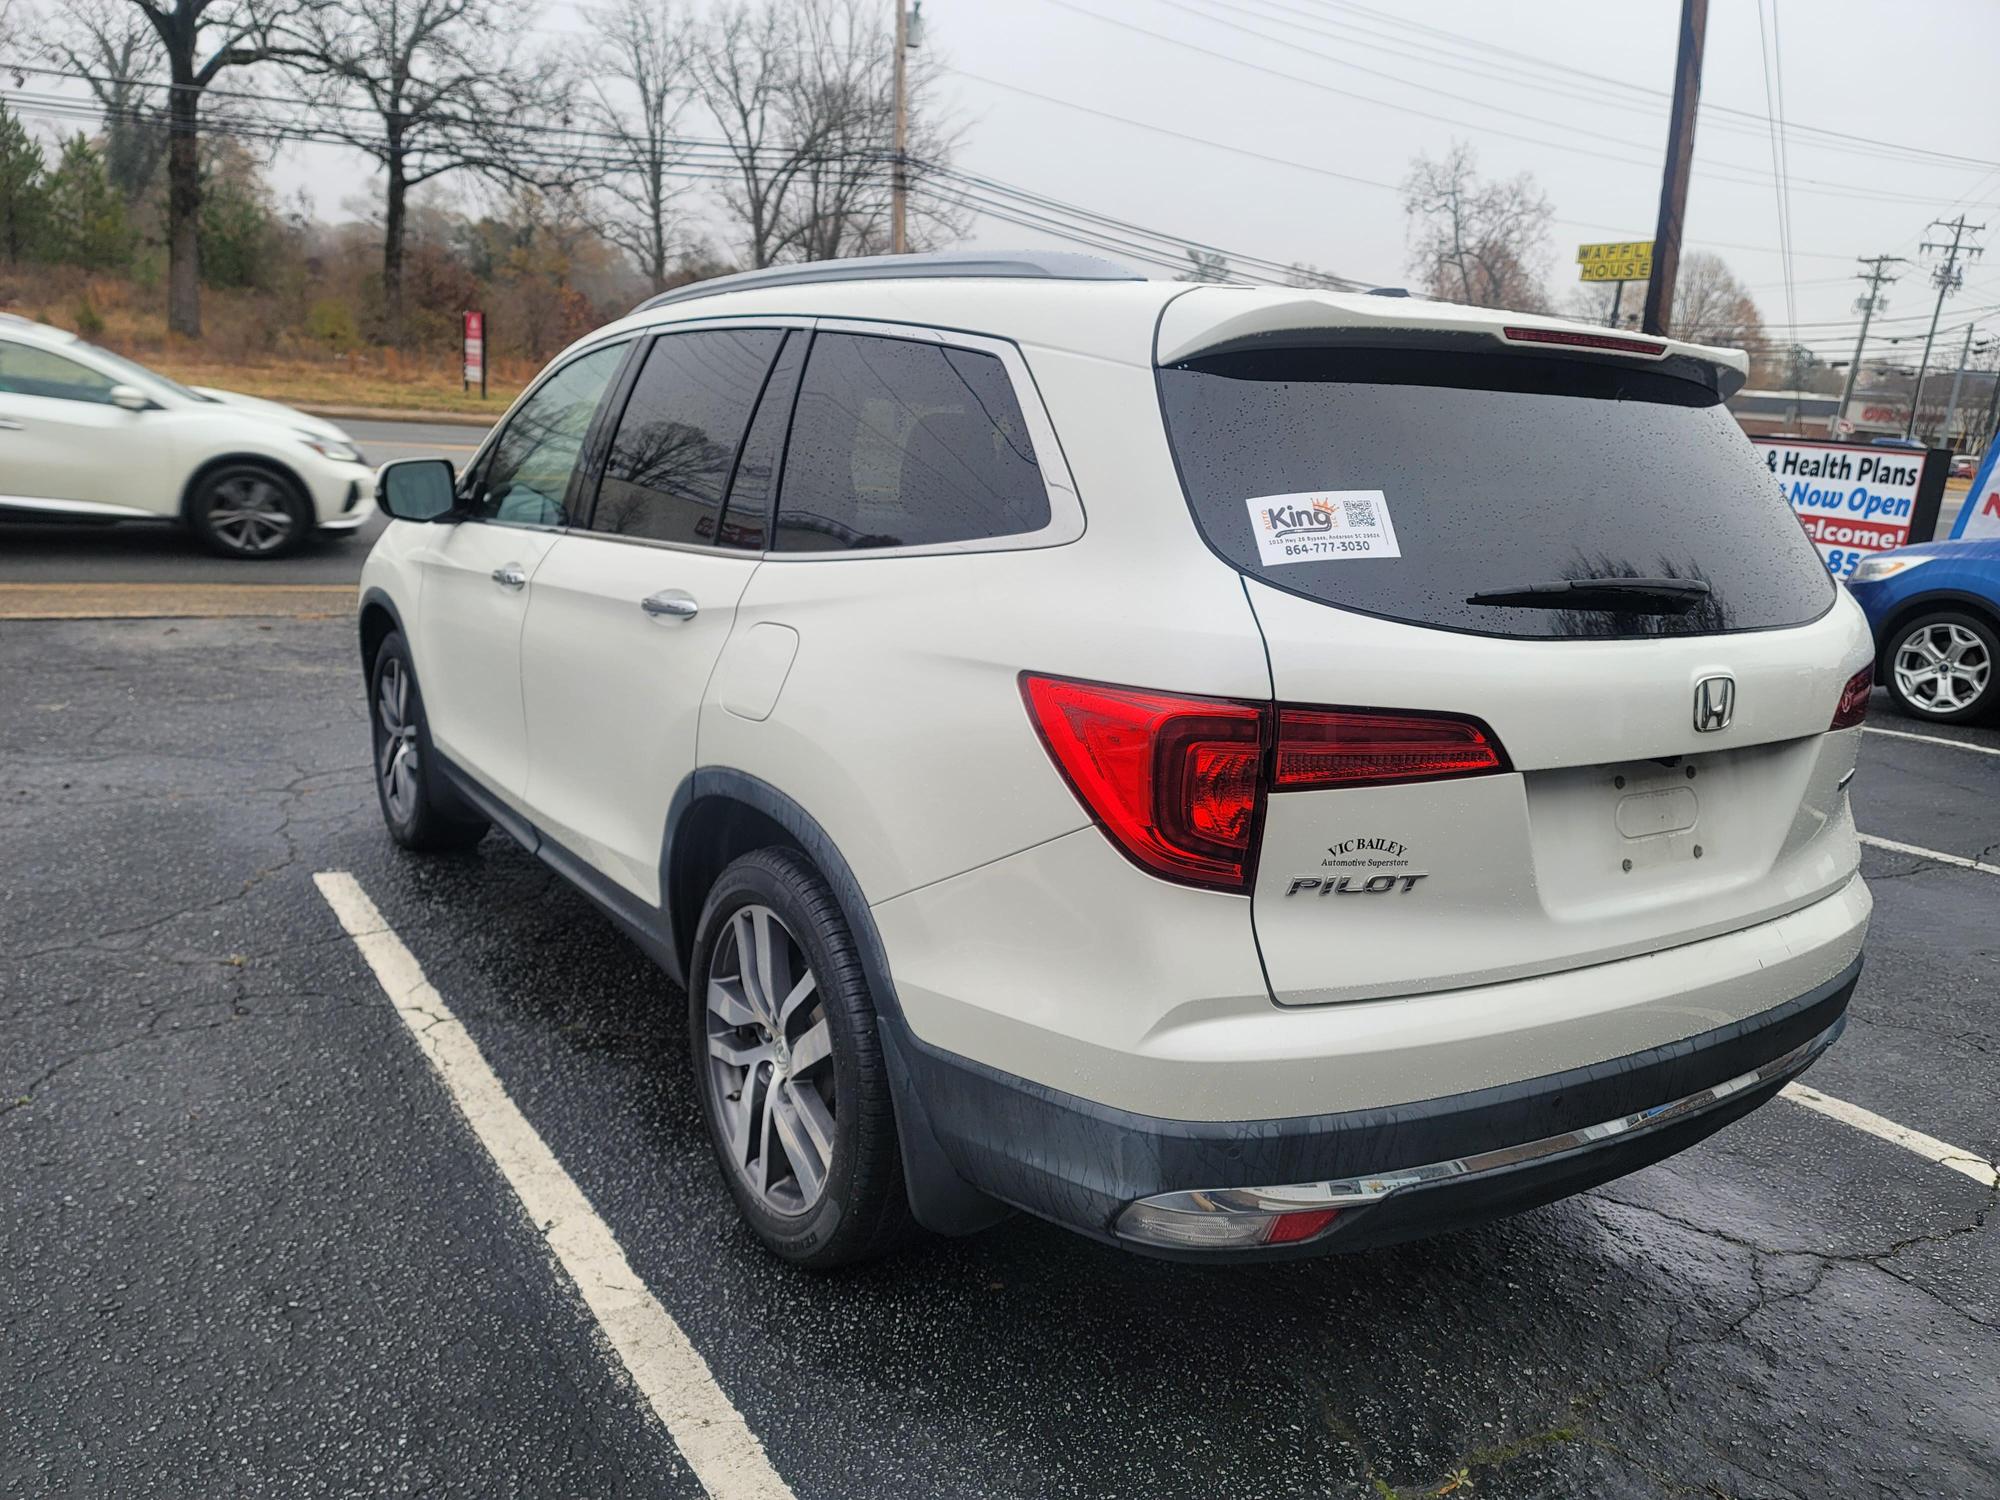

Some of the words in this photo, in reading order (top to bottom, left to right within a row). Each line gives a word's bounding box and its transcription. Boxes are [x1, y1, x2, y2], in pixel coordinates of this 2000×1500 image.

[1579, 243, 1645, 259] WAFFL
[1581, 262, 1649, 277] HOUSE
[1782, 451, 1852, 481] Health
[1857, 457, 1918, 487] Plans
[1790, 481, 1843, 509] Now
[1848, 487, 1911, 519] Open
[1268, 505, 1332, 533] King
[1801, 517, 1906, 549] elcome!
[1285, 541, 1370, 556] 864-777-3030
[1328, 840, 1354, 857] VIC
[1357, 838, 1407, 857] BAILEY
[1321, 858, 1366, 867] Automotive
[1368, 858, 1409, 868] Superstore
[1285, 872, 1430, 896] PILOT
